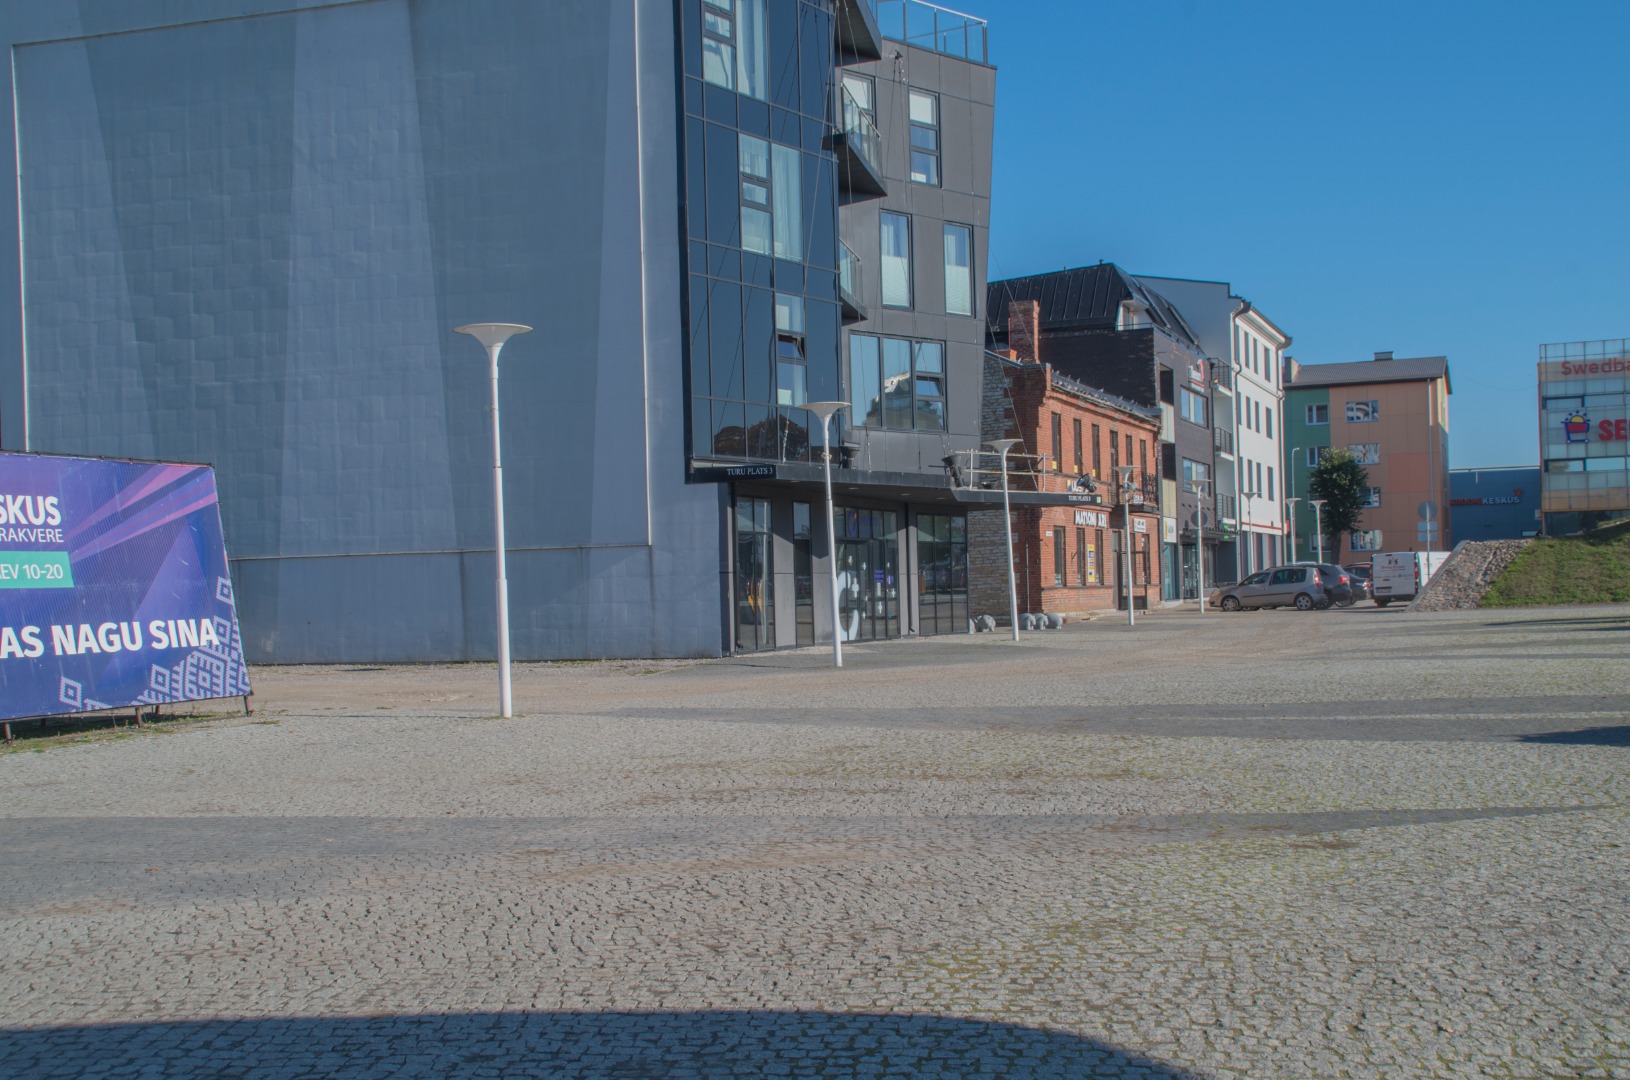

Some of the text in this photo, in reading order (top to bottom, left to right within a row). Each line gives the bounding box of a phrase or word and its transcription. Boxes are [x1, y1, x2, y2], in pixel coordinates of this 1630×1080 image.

[1598, 418, 1630, 441] SE
[727, 467, 774, 476] TURU PLATS 3
[0, 527, 65, 543] RAKVERE
[22, 563, 64, 580] 10-20
[51, 621, 142, 656] NAGU
[148, 618, 219, 650] SINA
